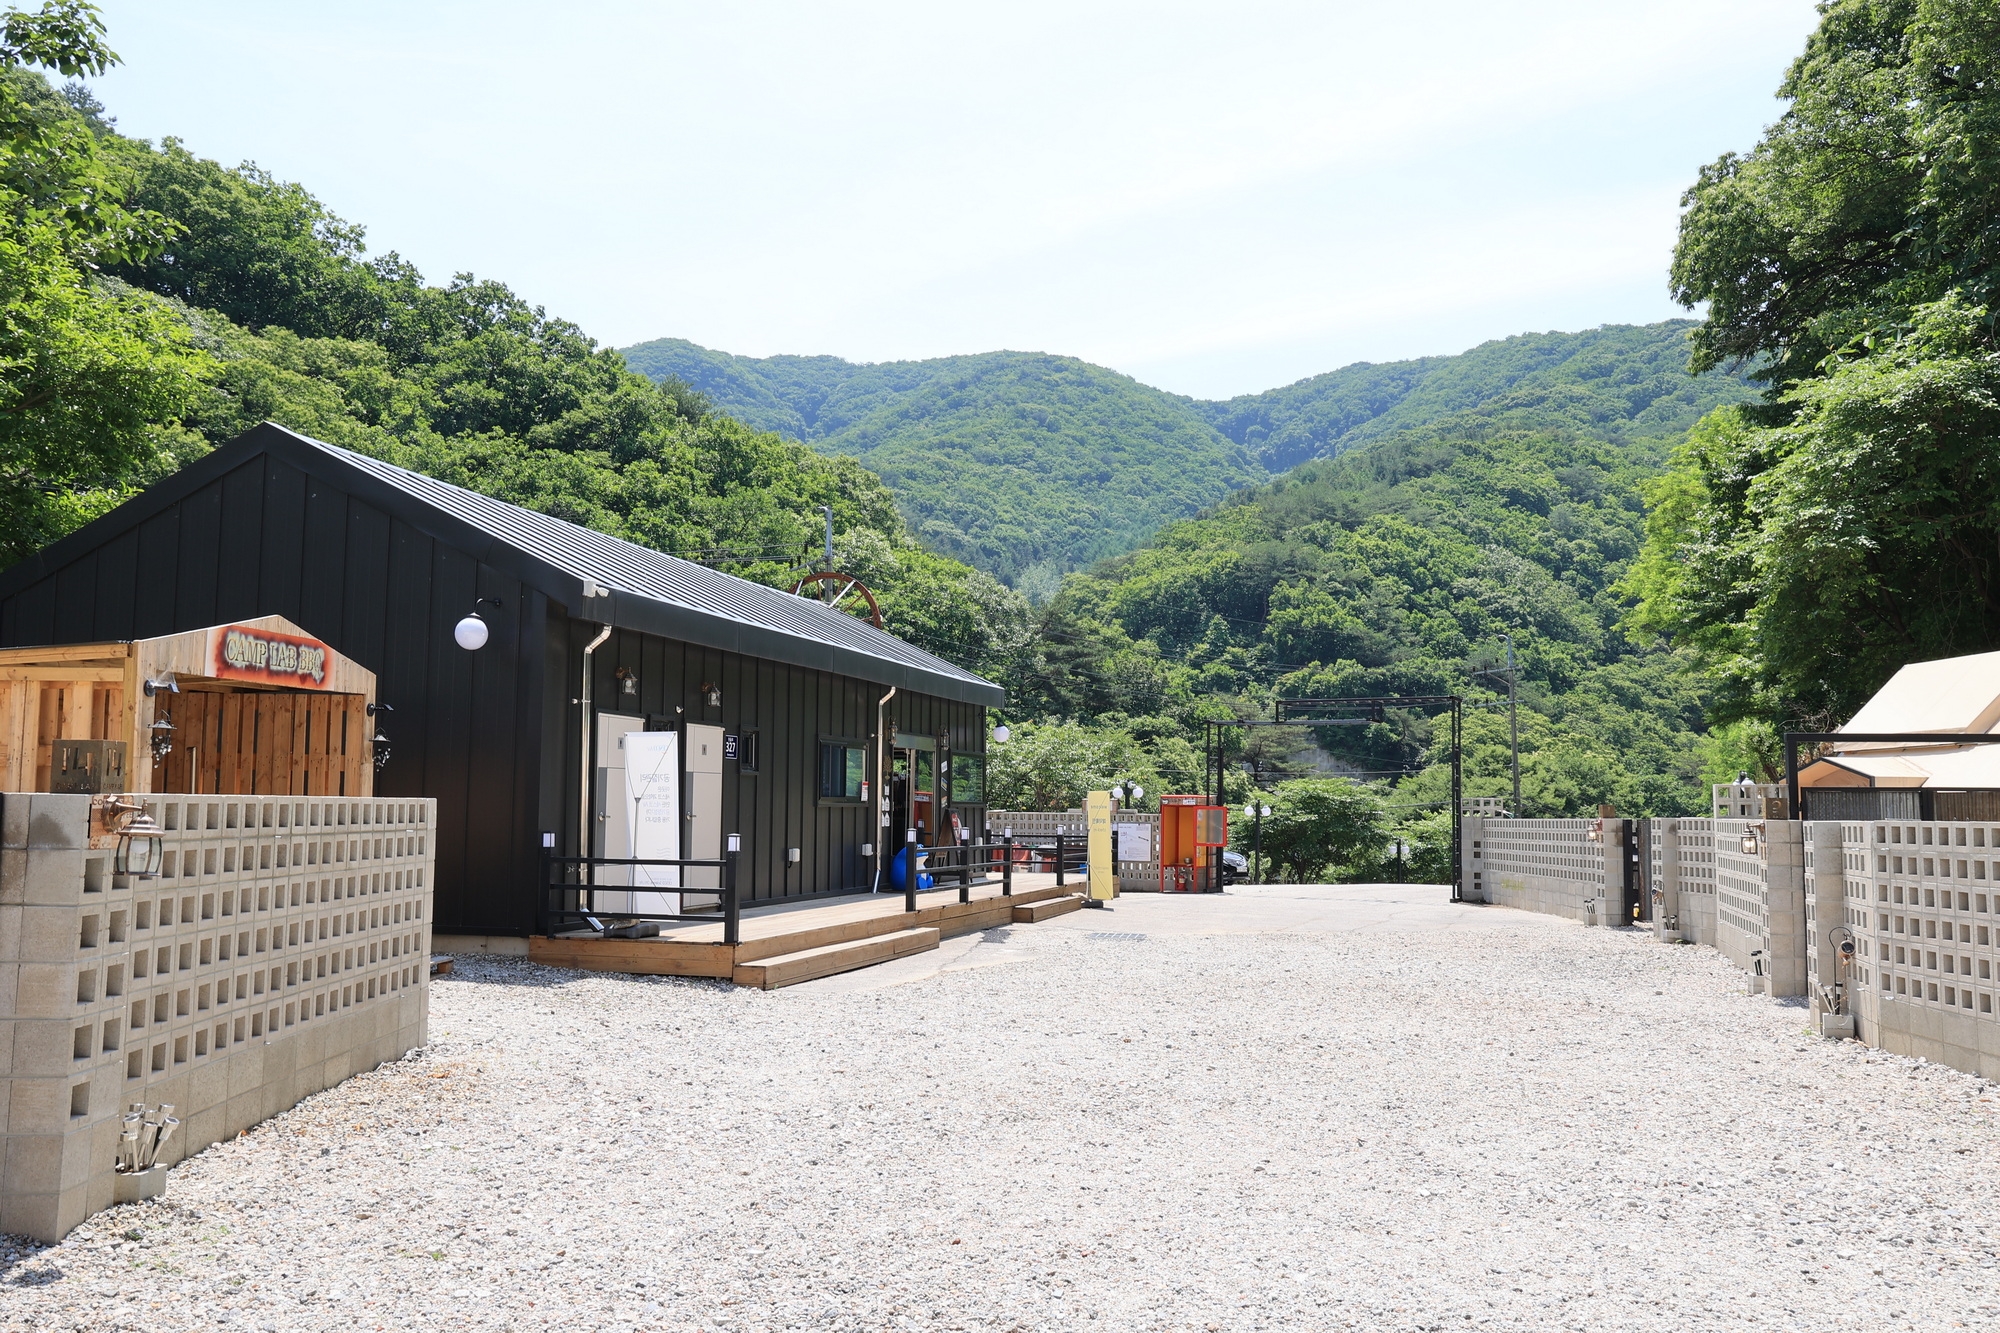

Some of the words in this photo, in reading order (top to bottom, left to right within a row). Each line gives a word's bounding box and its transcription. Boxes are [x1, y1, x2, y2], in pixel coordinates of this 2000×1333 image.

[225, 637, 267, 665] CAMP
[269, 643, 297, 669] LAB
[299, 648, 325, 677] BBQ
[725, 742, 736, 752] 327
